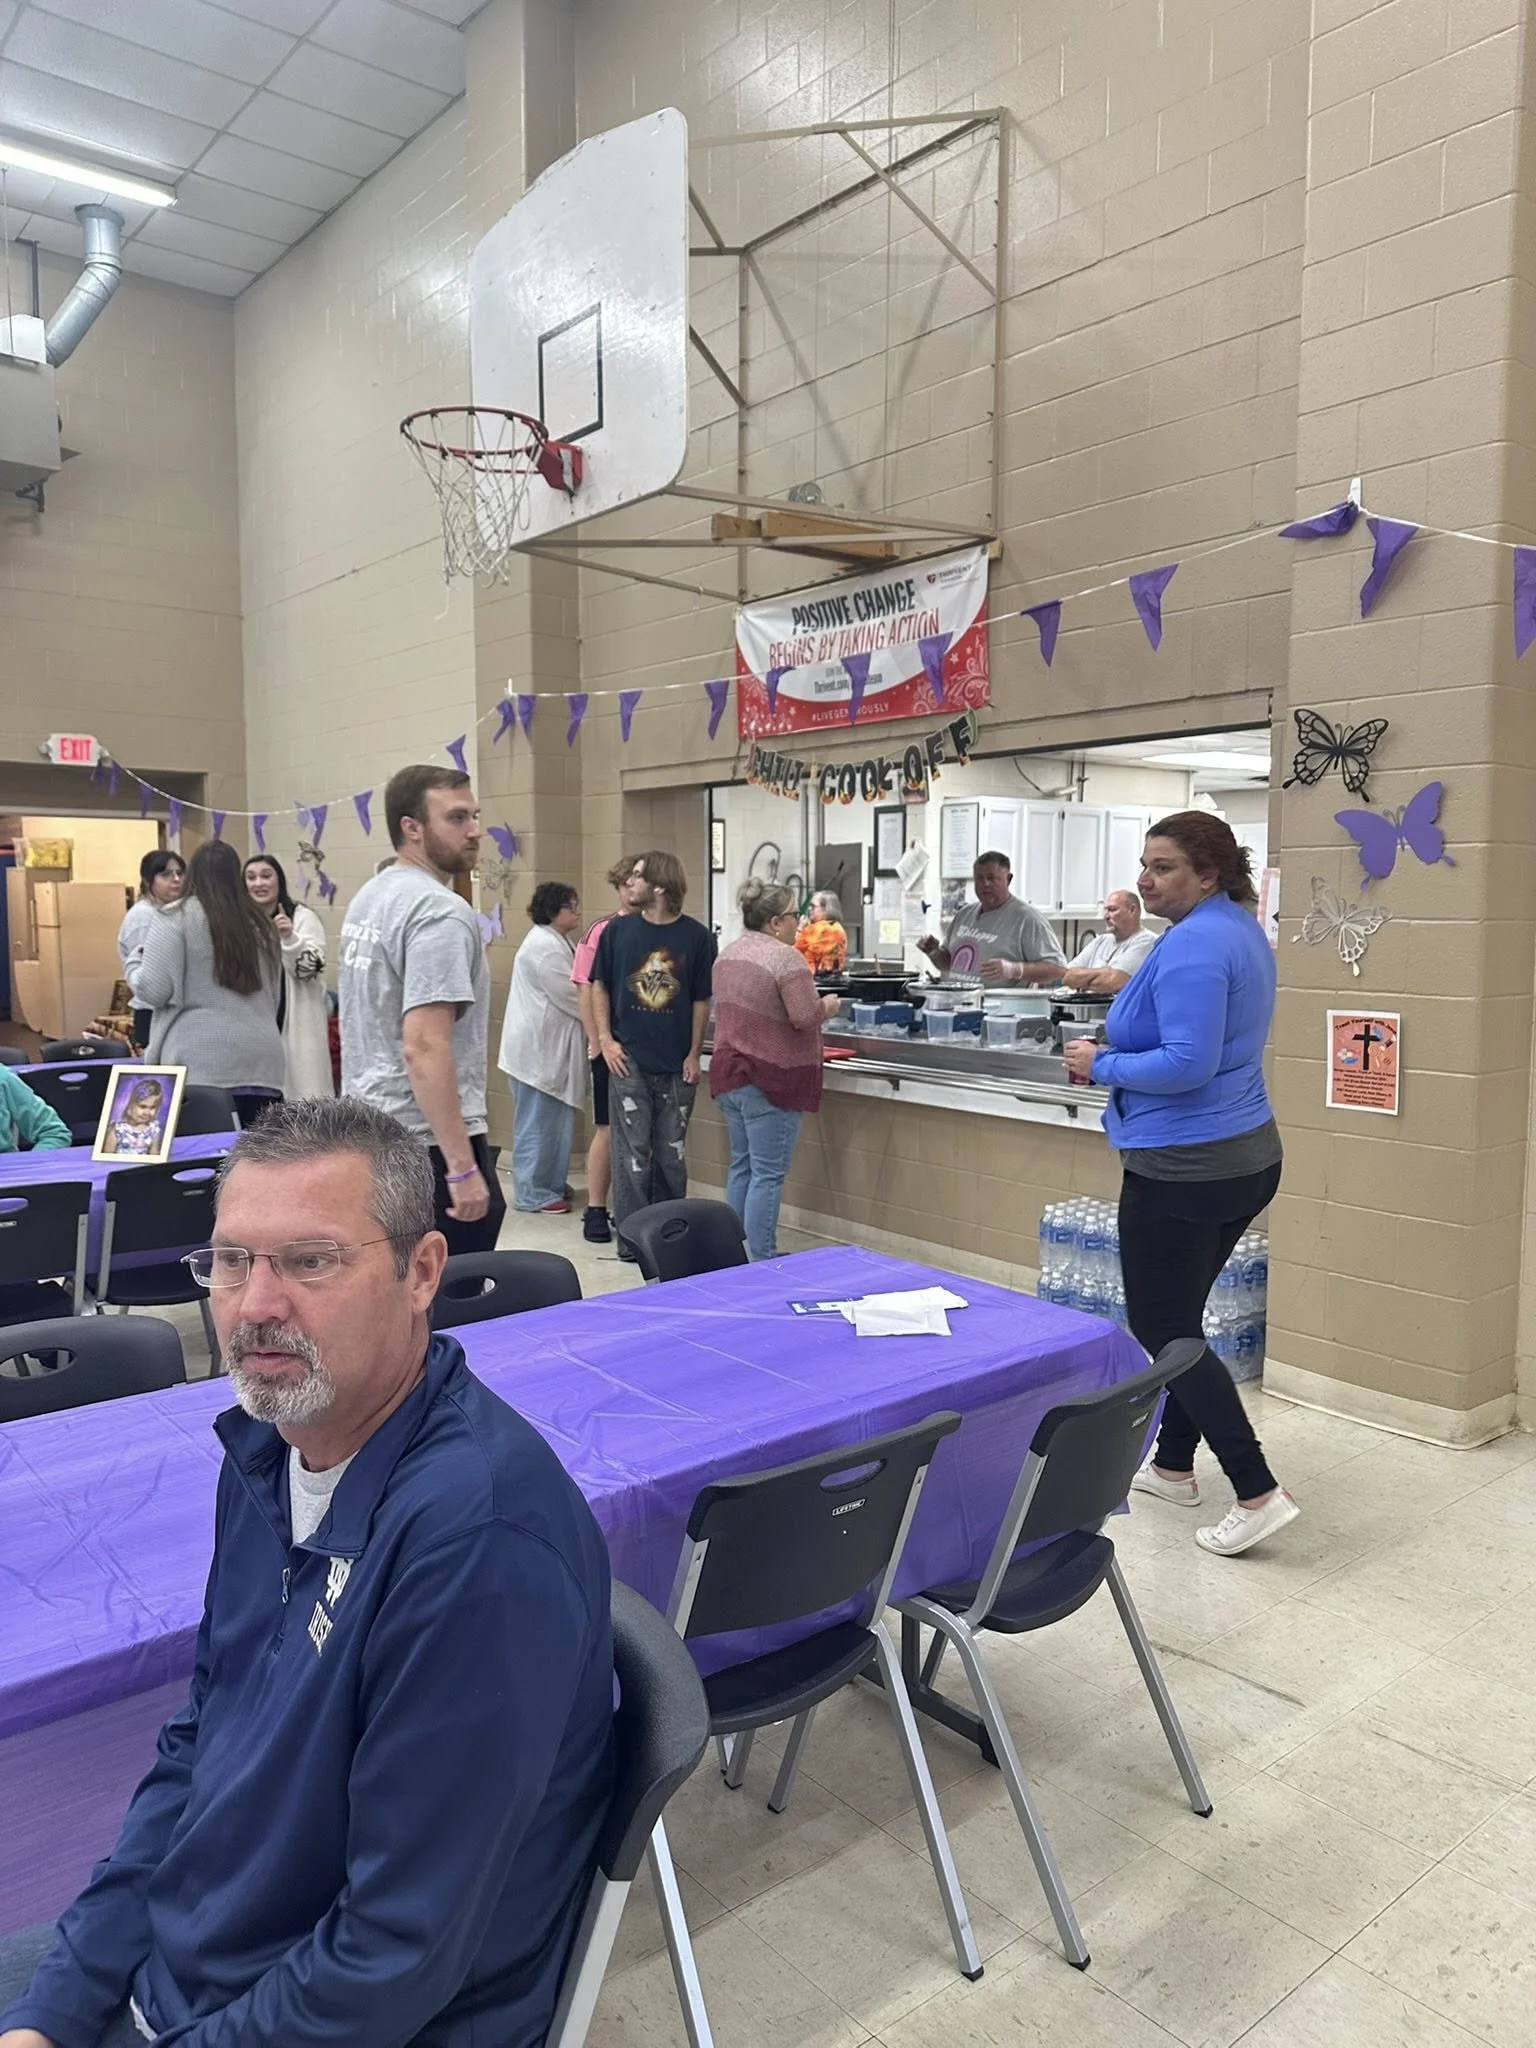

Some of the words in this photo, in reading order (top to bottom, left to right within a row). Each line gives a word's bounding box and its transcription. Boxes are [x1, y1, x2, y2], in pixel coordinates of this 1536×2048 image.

[792, 596, 853, 635] POSITIVE
[852, 579, 915, 622] CHANGE
[769, 633, 815, 669] BEGINS
[817, 632, 839, 662] BY
[838, 620, 886, 657] TAKING
[888, 608, 940, 644] ACTION
[60, 737, 91, 761] EXIT
[819, 756, 893, 804] COOK
